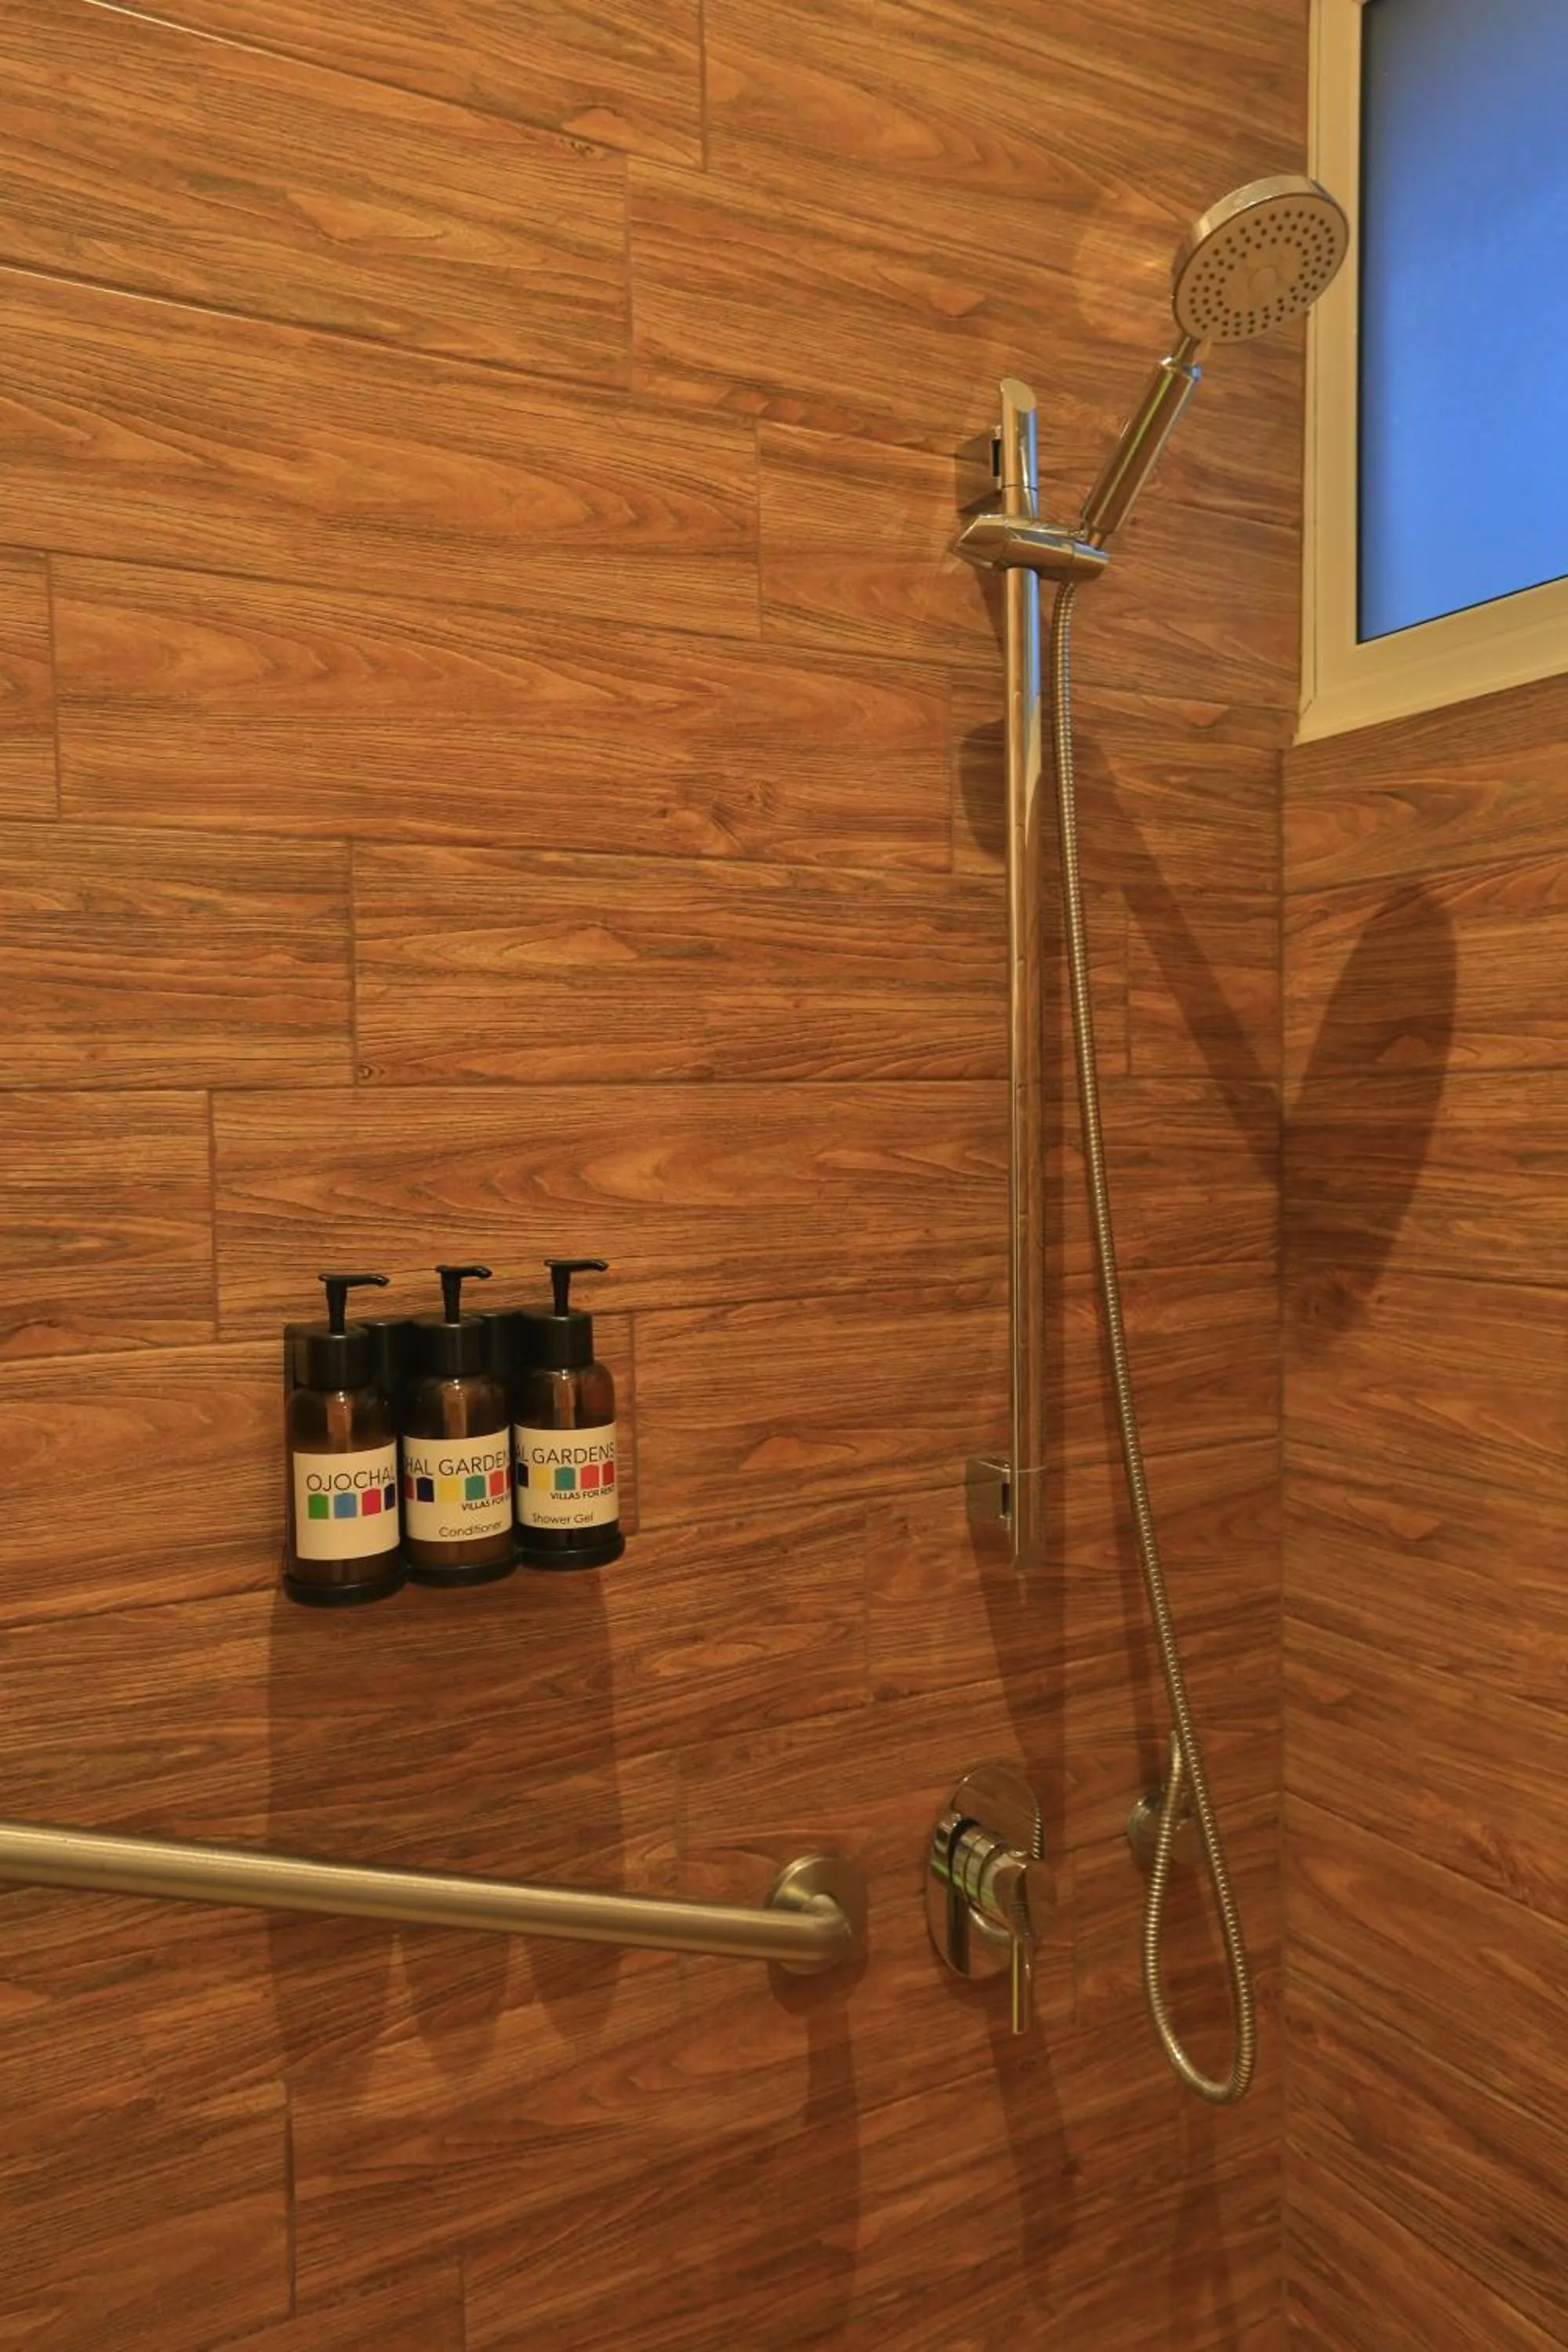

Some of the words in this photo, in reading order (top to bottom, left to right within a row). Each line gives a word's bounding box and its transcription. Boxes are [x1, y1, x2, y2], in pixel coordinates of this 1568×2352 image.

[583, 1490, 600, 1498] FOR
[461, 1499, 489, 1511] VILLAS
[532, 1512, 570, 1525] Shower
[573, 1512, 593, 1523] Gel
[438, 1521, 503, 1537] Conditioner
